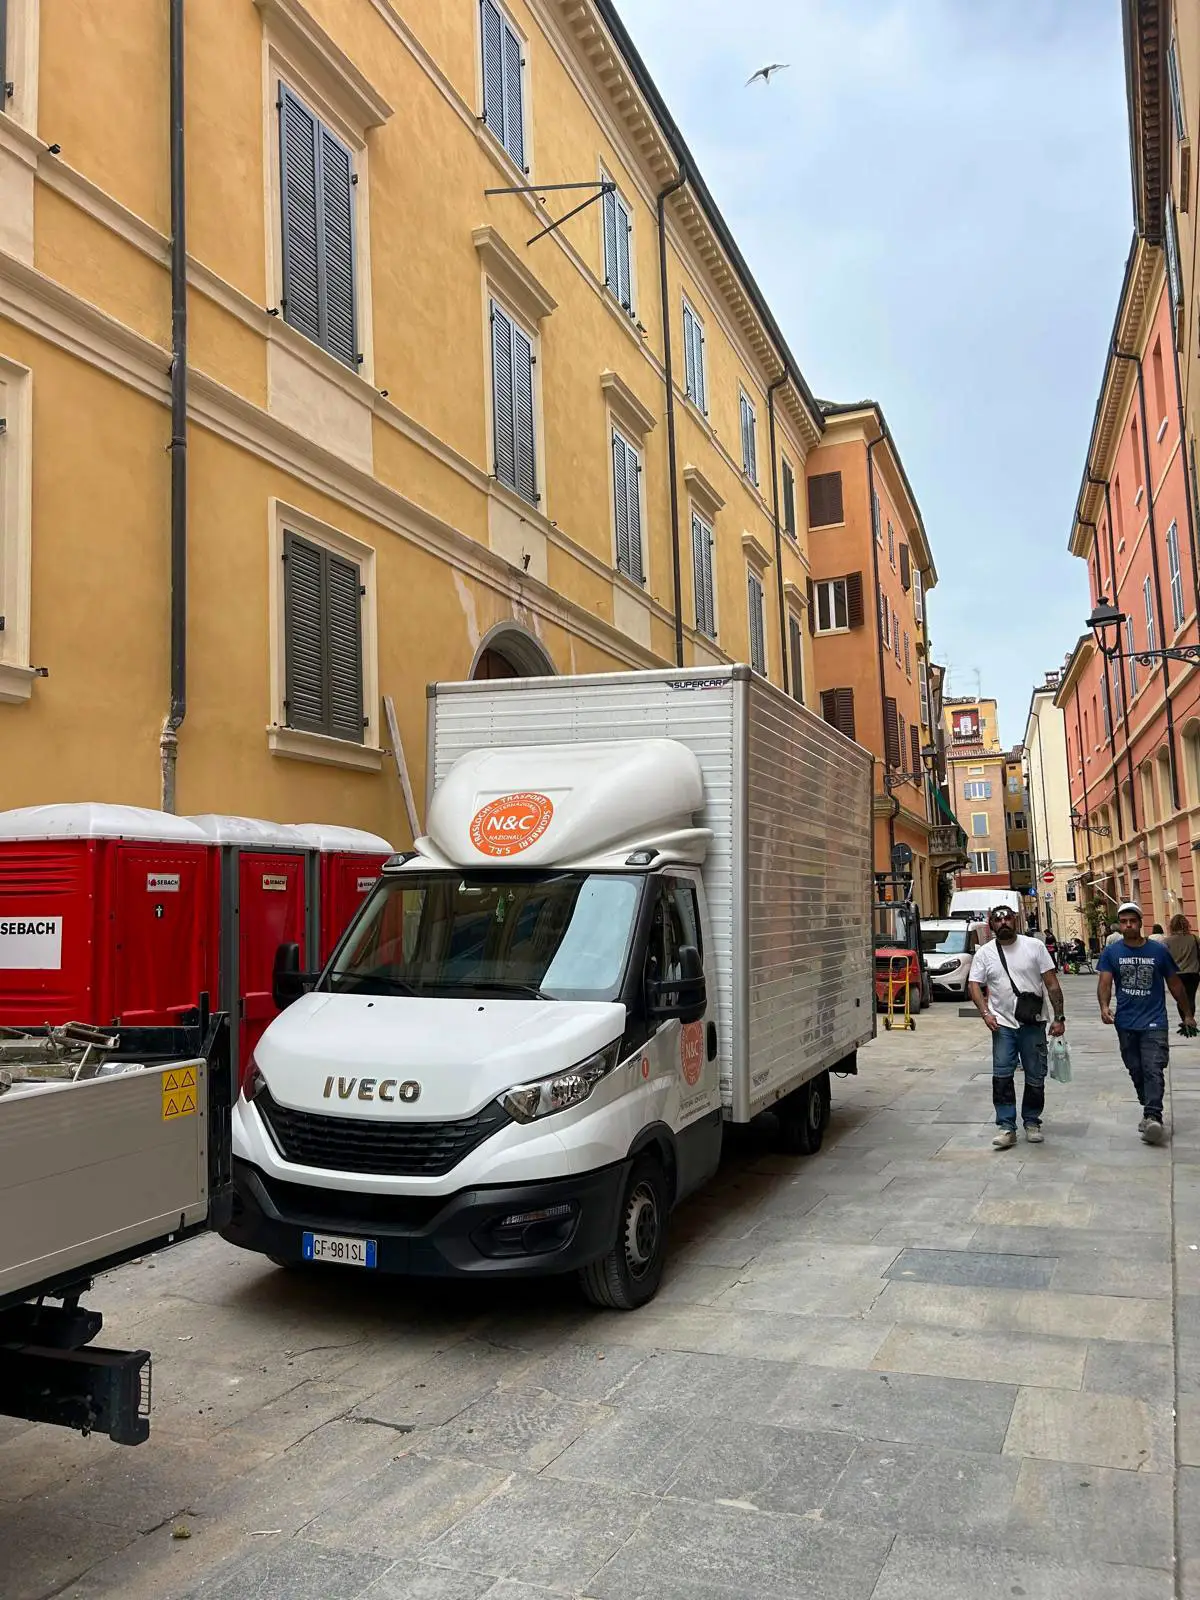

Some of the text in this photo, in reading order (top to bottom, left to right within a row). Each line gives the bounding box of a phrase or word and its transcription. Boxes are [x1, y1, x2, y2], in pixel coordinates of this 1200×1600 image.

[673, 679, 725, 689] SUPERCAR
[486, 815, 535, 831] N&C
[0, 922, 56, 935] SEBACH
[323, 1076, 421, 1103] IVECO
